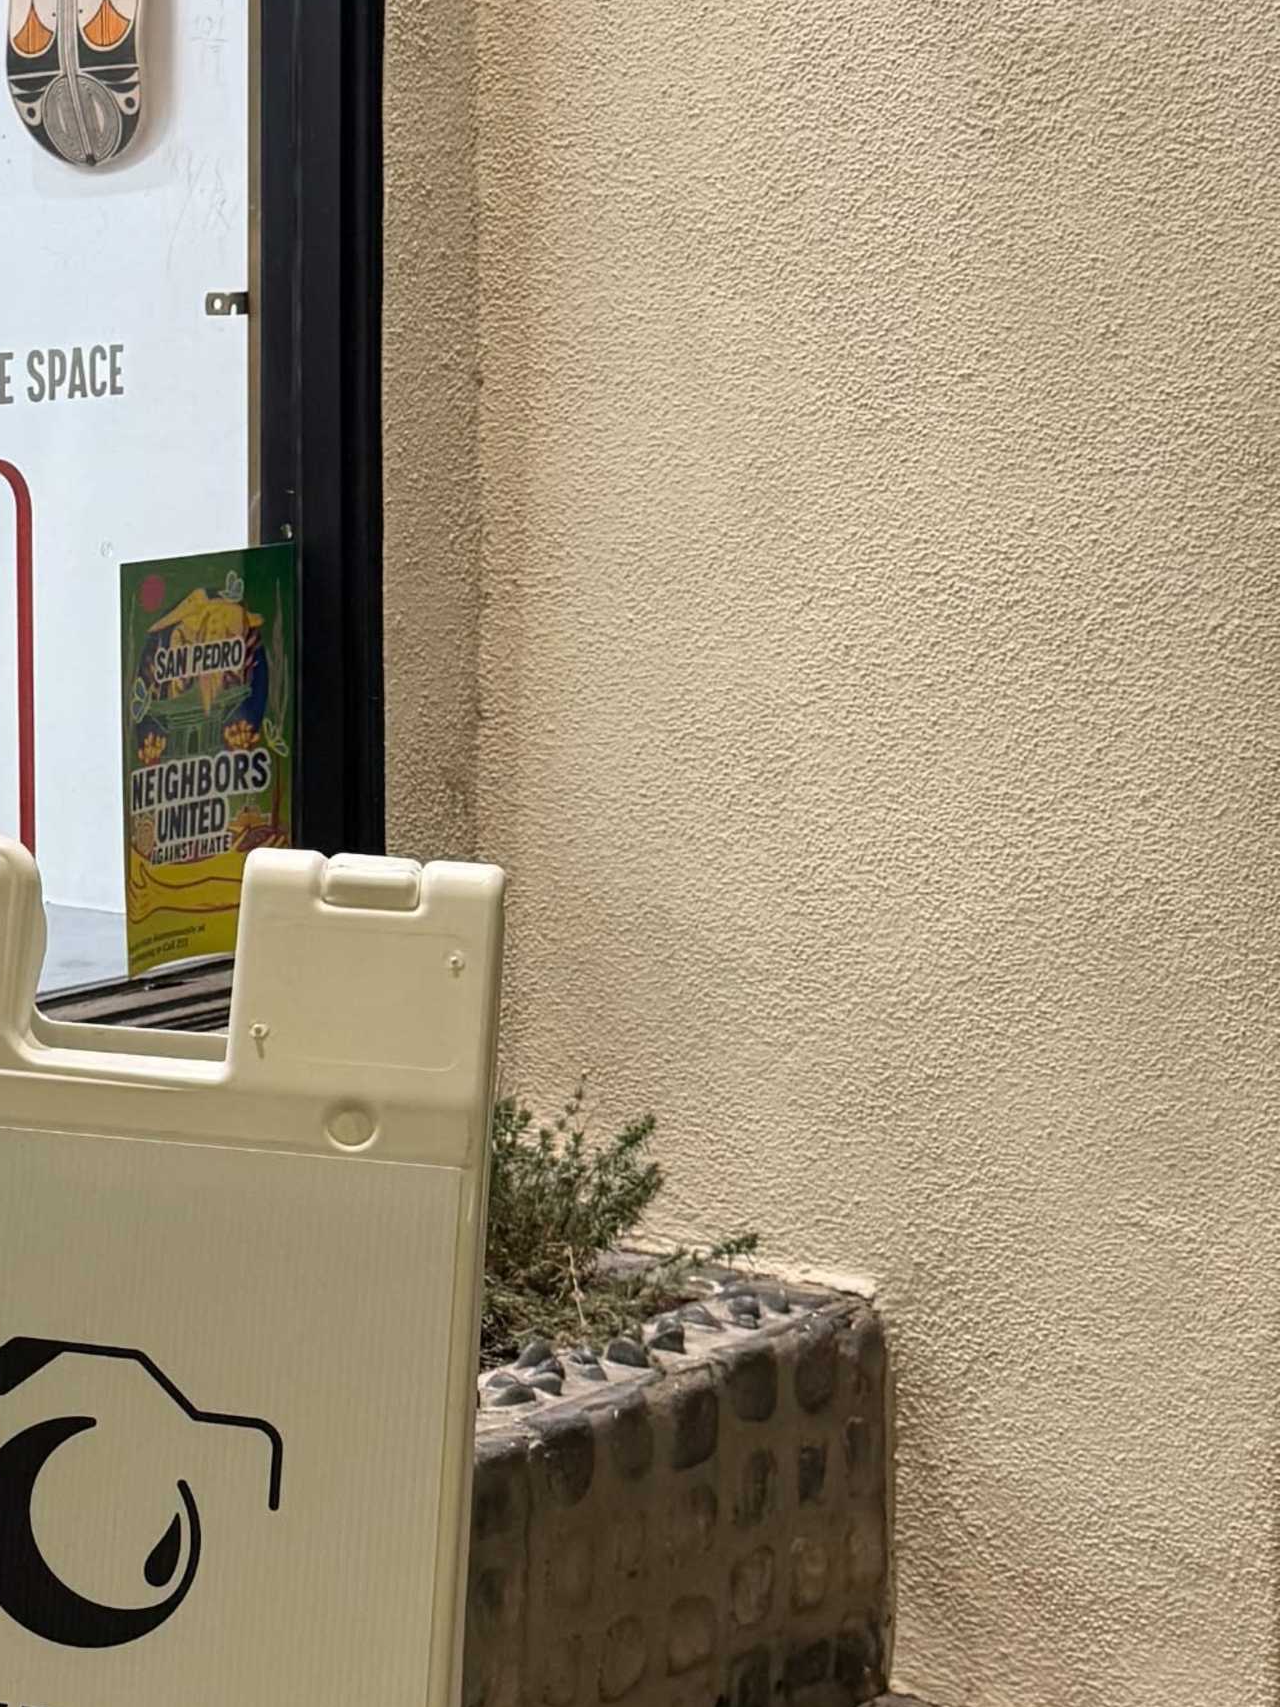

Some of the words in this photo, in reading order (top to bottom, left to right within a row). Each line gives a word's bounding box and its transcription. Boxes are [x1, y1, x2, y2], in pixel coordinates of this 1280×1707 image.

[27, 344, 125, 403] SPACE
[155, 646, 188, 681] SAN
[192, 639, 243, 675] PEDRO
[131, 749, 270, 812] NEIGHBORS
[156, 797, 227, 844] UNITED
[151, 843, 194, 866] AGAINST
[198, 838, 231, 858] HATE
